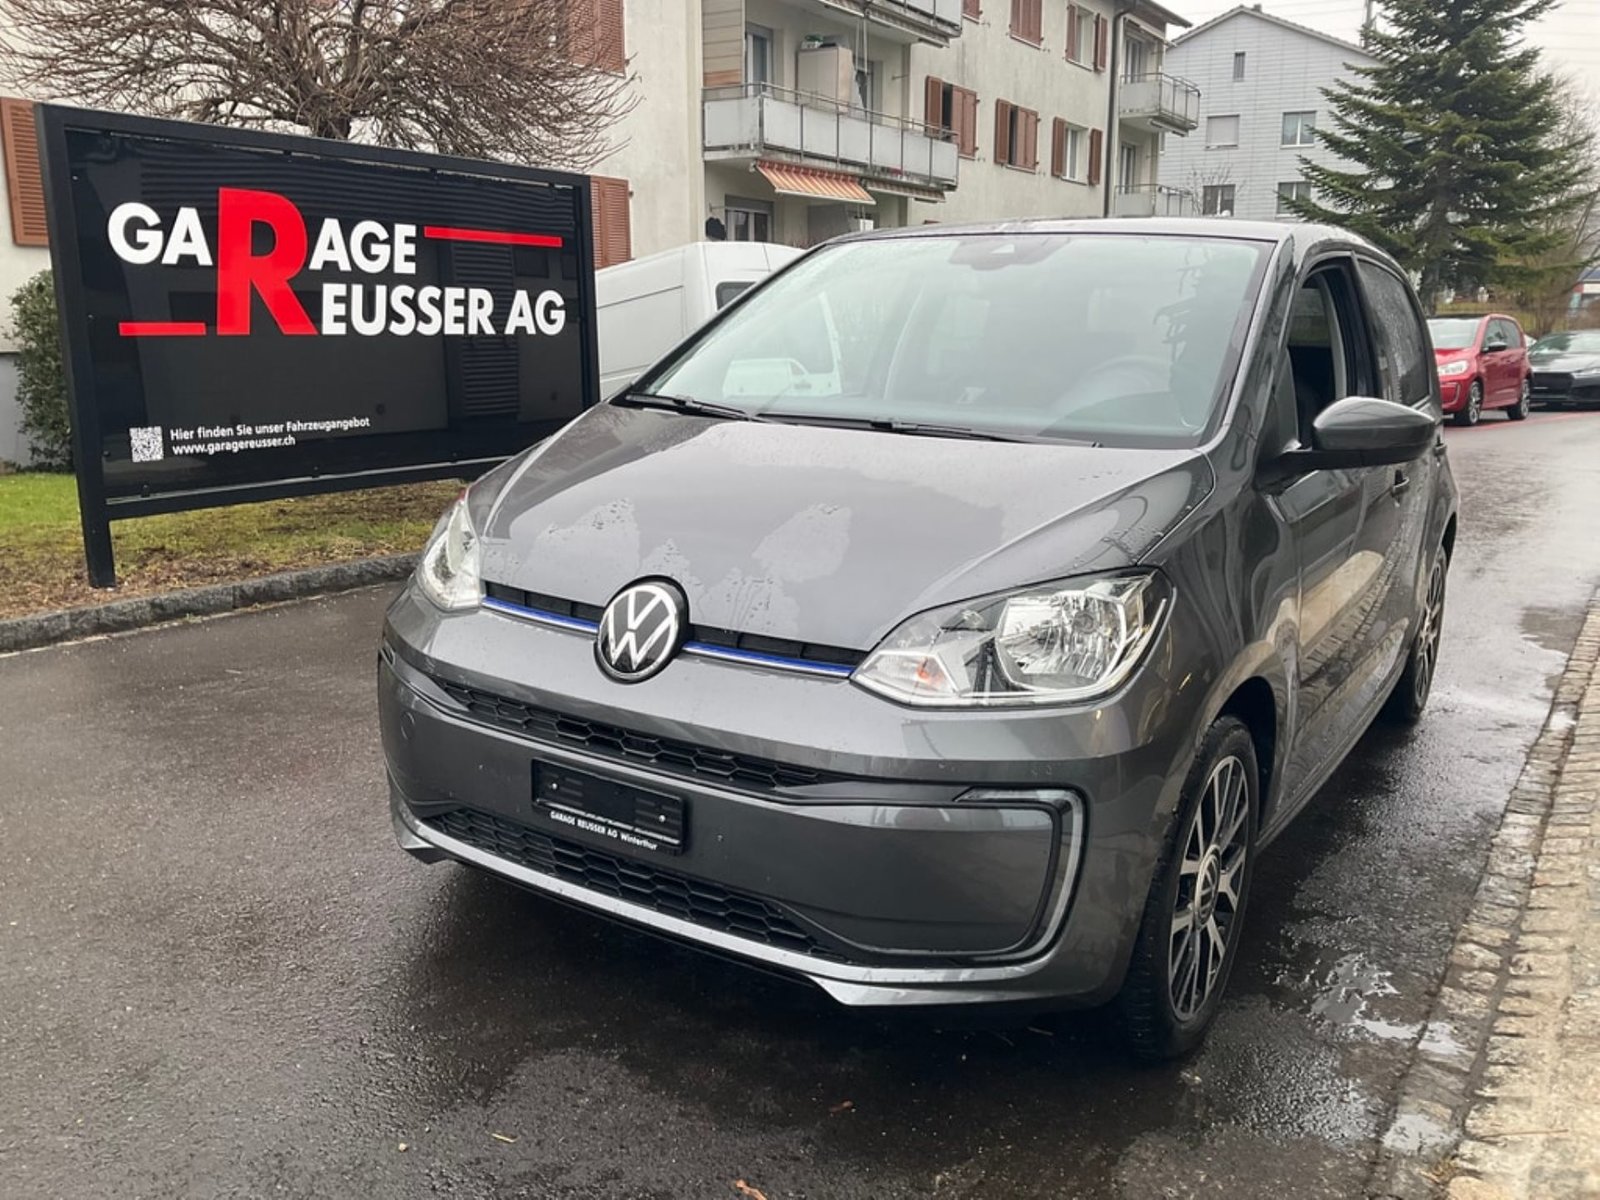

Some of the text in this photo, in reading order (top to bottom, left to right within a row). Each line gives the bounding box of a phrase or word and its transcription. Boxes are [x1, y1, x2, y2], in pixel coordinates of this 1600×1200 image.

[107, 187, 417, 335] GARAGE
[504, 289, 566, 336] AG
[170, 416, 370, 440] Hier finden Sie unser Fahrzeugangebot
[172, 434, 296, 455] www.garagereusser.ch
[550, 810, 658, 851] GARAGE REUSSER AG Winterthur
